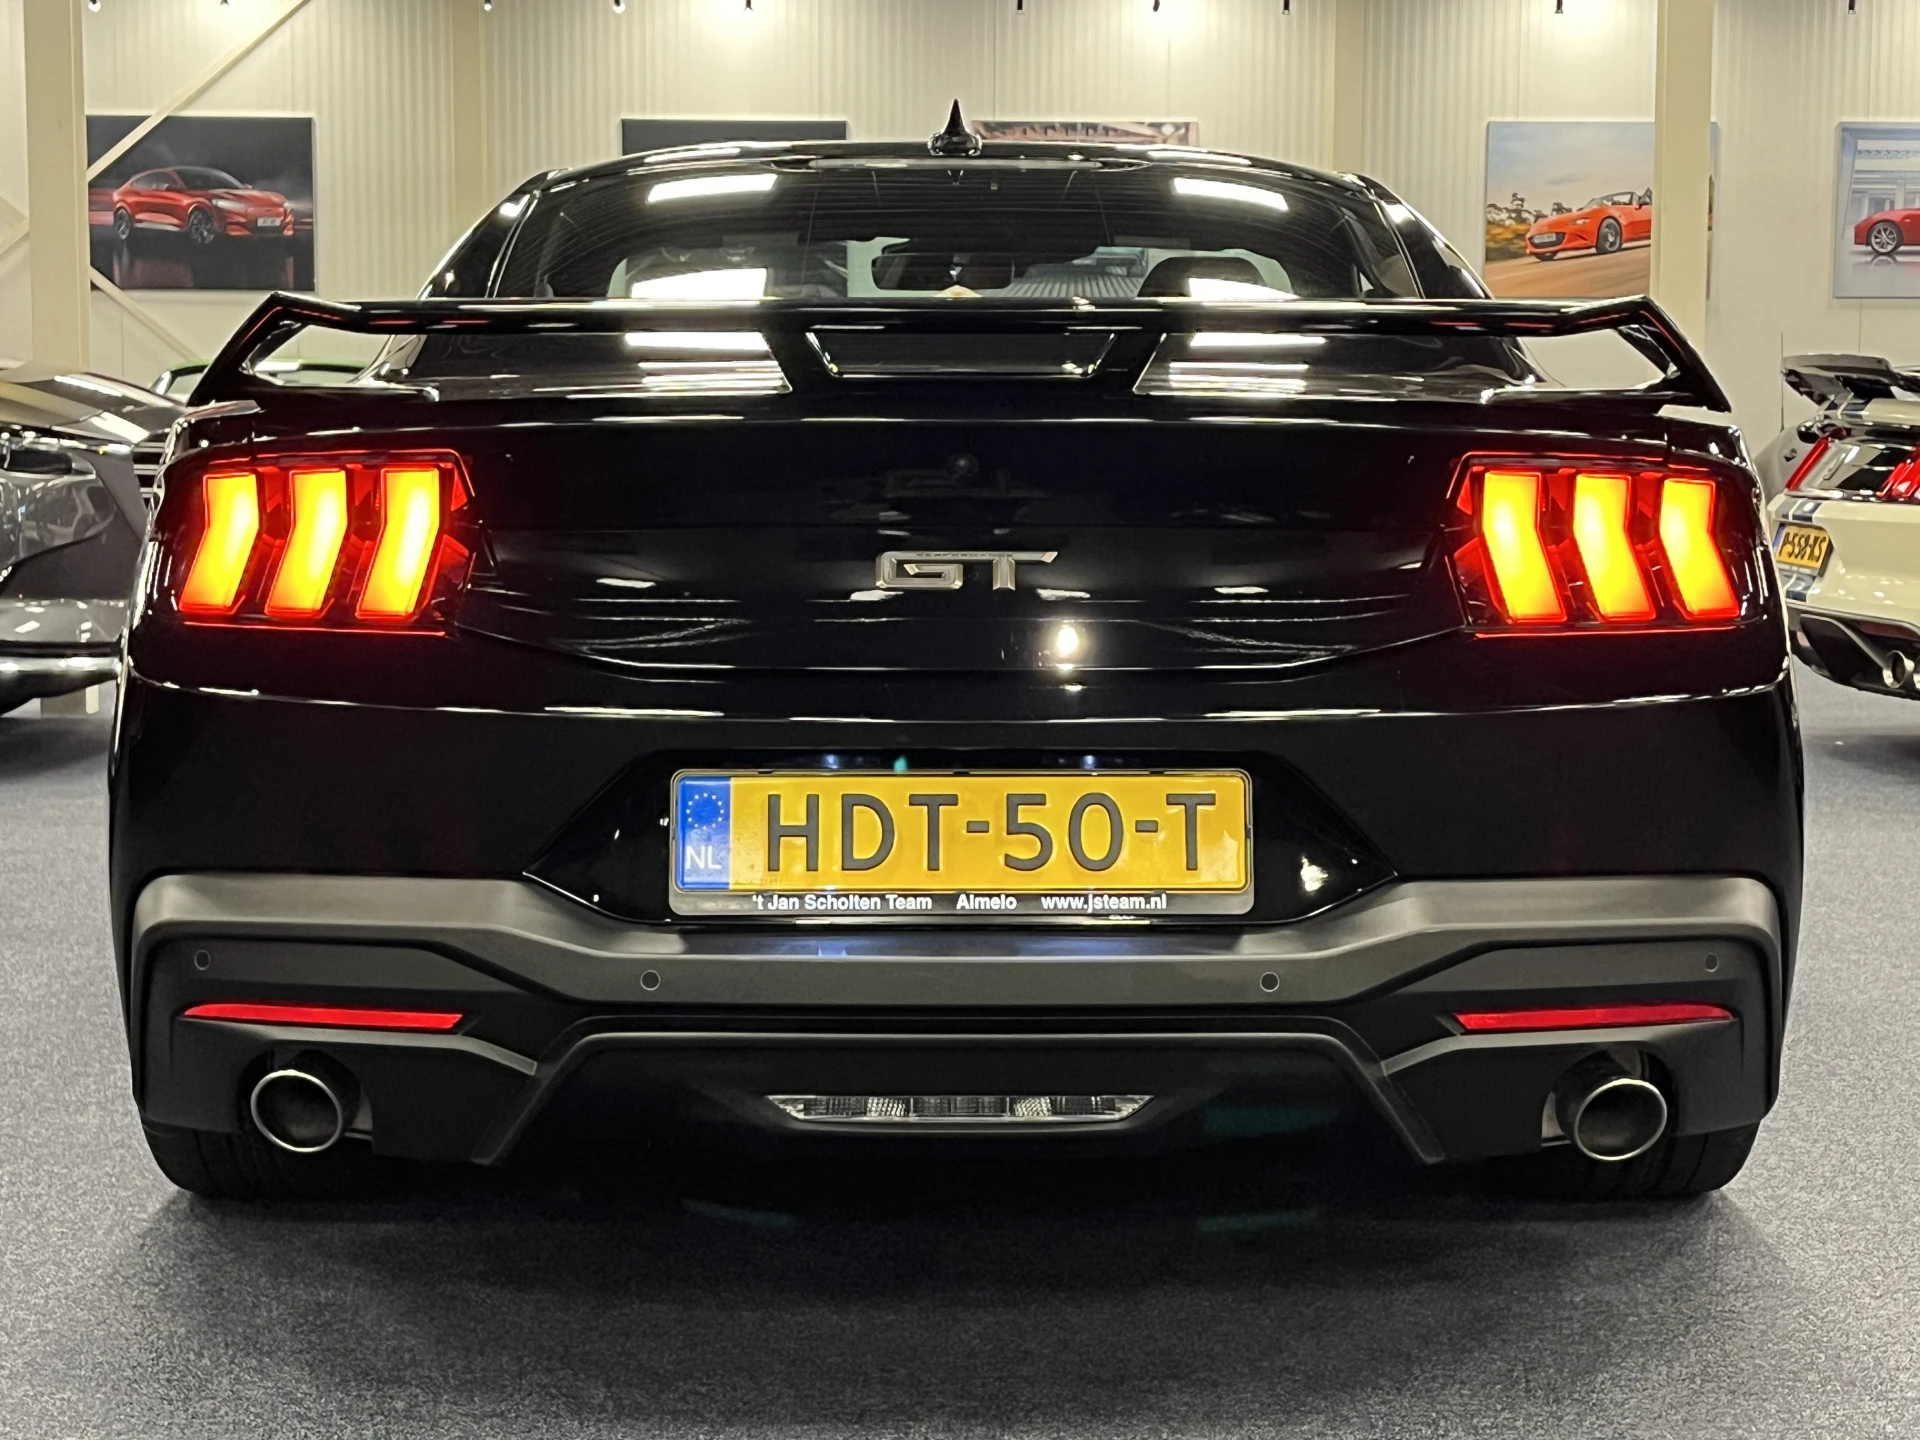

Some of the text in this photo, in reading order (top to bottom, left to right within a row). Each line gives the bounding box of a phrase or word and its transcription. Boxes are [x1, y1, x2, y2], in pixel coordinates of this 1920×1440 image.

[876, 551, 1058, 590] GT
[768, 792, 1216, 871] HDT-50-T
[686, 845, 722, 869] NL
[768, 895, 799, 910] Jan
[804, 895, 881, 910] Scholten
[886, 895, 932, 909] Team
[956, 894, 1017, 909] Almelo
[1041, 893, 1167, 912] www.jsteam.nl
